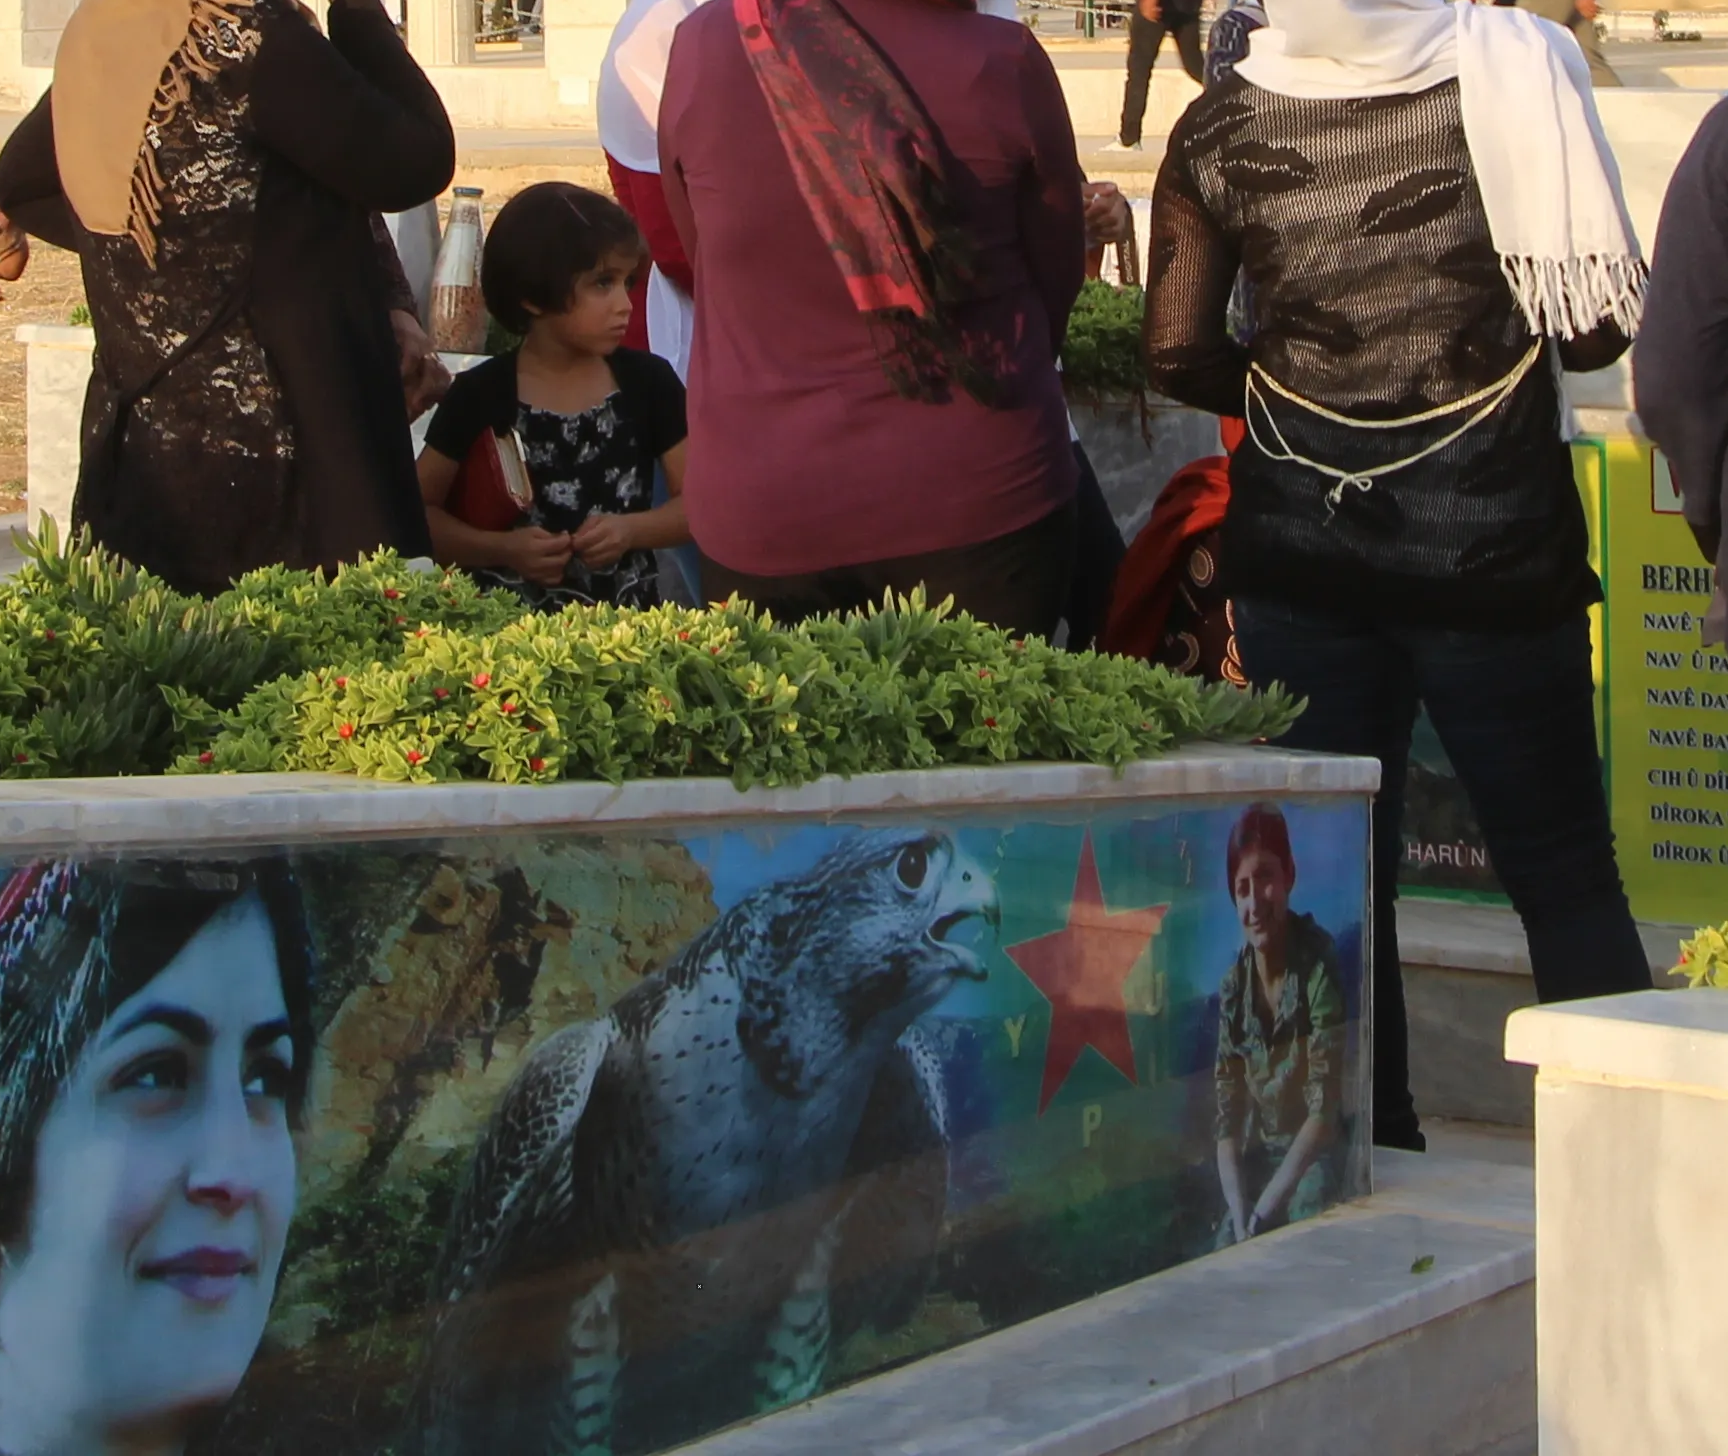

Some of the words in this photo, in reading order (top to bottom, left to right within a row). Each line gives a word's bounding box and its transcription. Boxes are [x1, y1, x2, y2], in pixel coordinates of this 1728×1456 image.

[1641, 564, 1712, 594] BERH
[1643, 611, 1692, 632] NAVÊ
[1645, 650, 1682, 668] NAV
[1691, 649, 1704, 670] Û
[1646, 686, 1696, 708] NAVÊ
[1648, 727, 1698, 748] NAVÊ
[1647, 768, 1682, 787] CIH
[1687, 767, 1699, 788] Û
[1650, 801, 1724, 828] DÎROKA
[1652, 839, 1713, 864] DÎROK
[1003, 1013, 1027, 1058] Y
[1081, 1103, 1103, 1149] P
